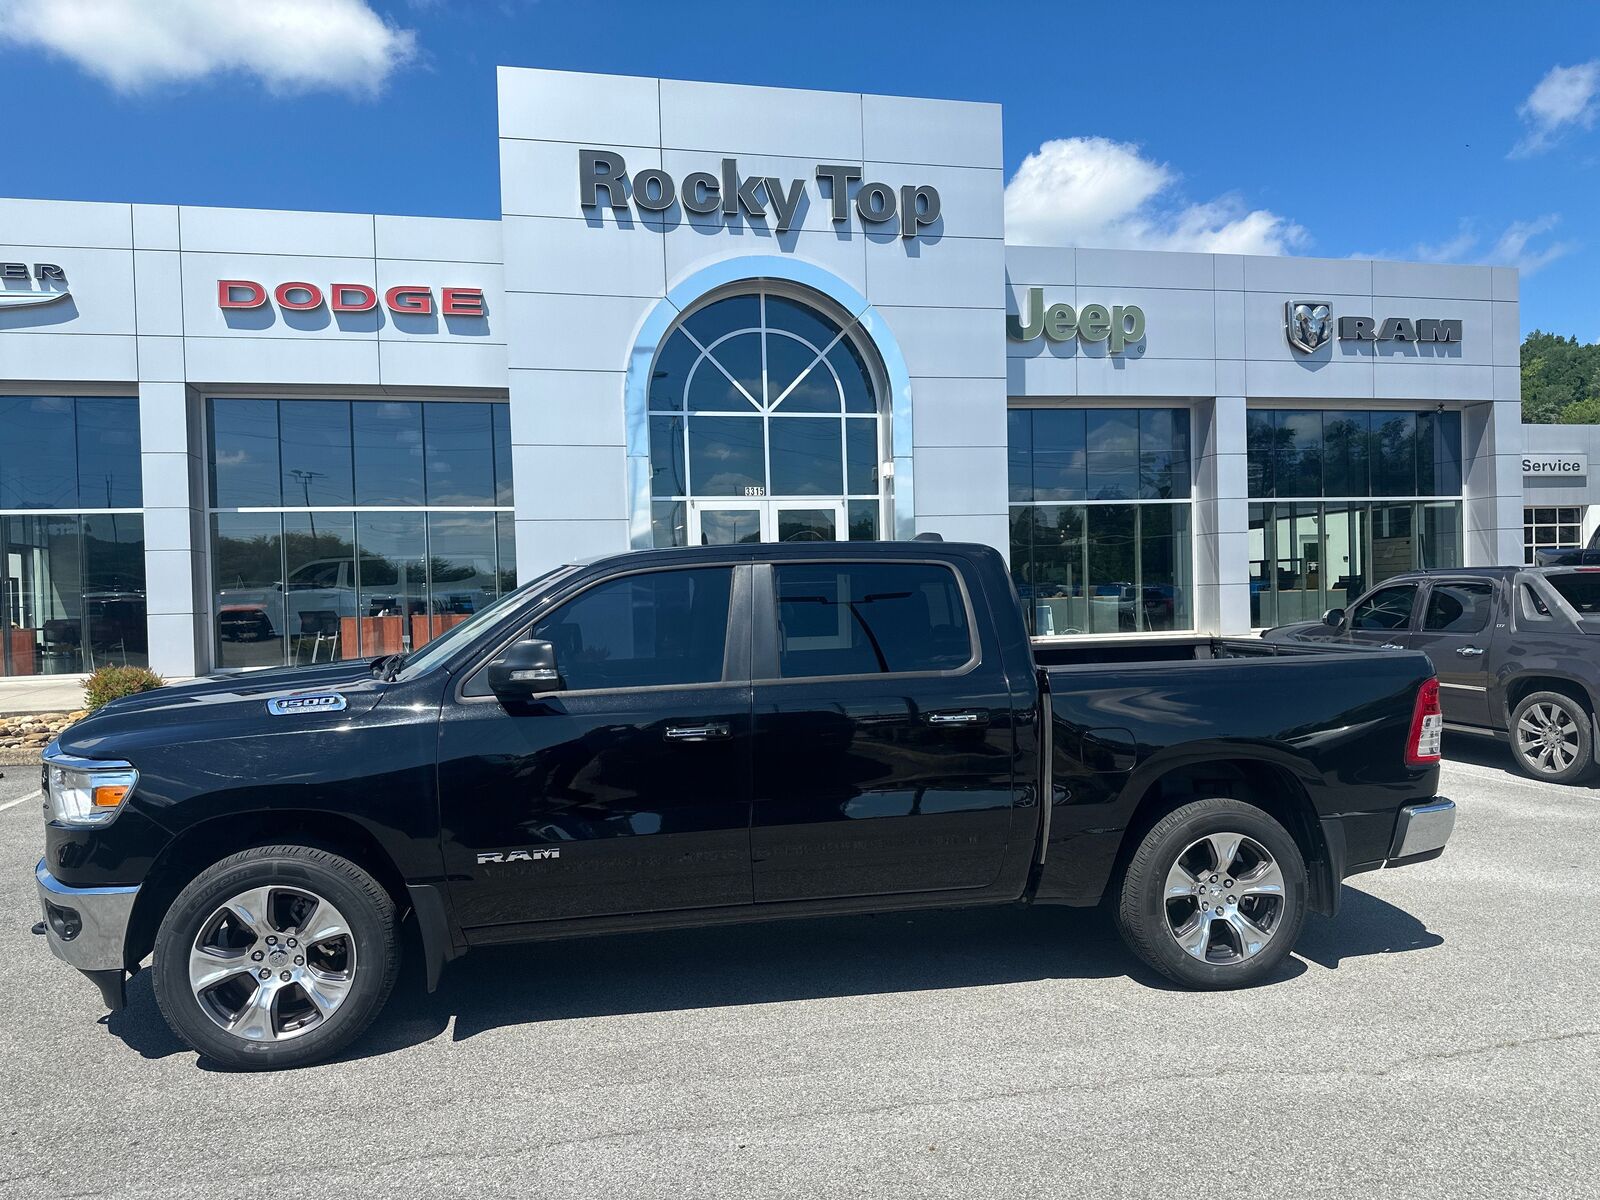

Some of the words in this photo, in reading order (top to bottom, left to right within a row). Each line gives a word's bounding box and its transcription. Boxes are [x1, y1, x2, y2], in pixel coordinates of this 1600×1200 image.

[578, 148, 806, 231] Rocky
[815, 164, 942, 239] Top
[217, 279, 485, 316] DODGE
[1006, 287, 1146, 353] Jeep
[1337, 316, 1463, 342] RAM
[1521, 459, 1581, 472] Service
[745, 487, 765, 496] 3315
[280, 697, 335, 708] 1500
[477, 847, 560, 864] RAM
